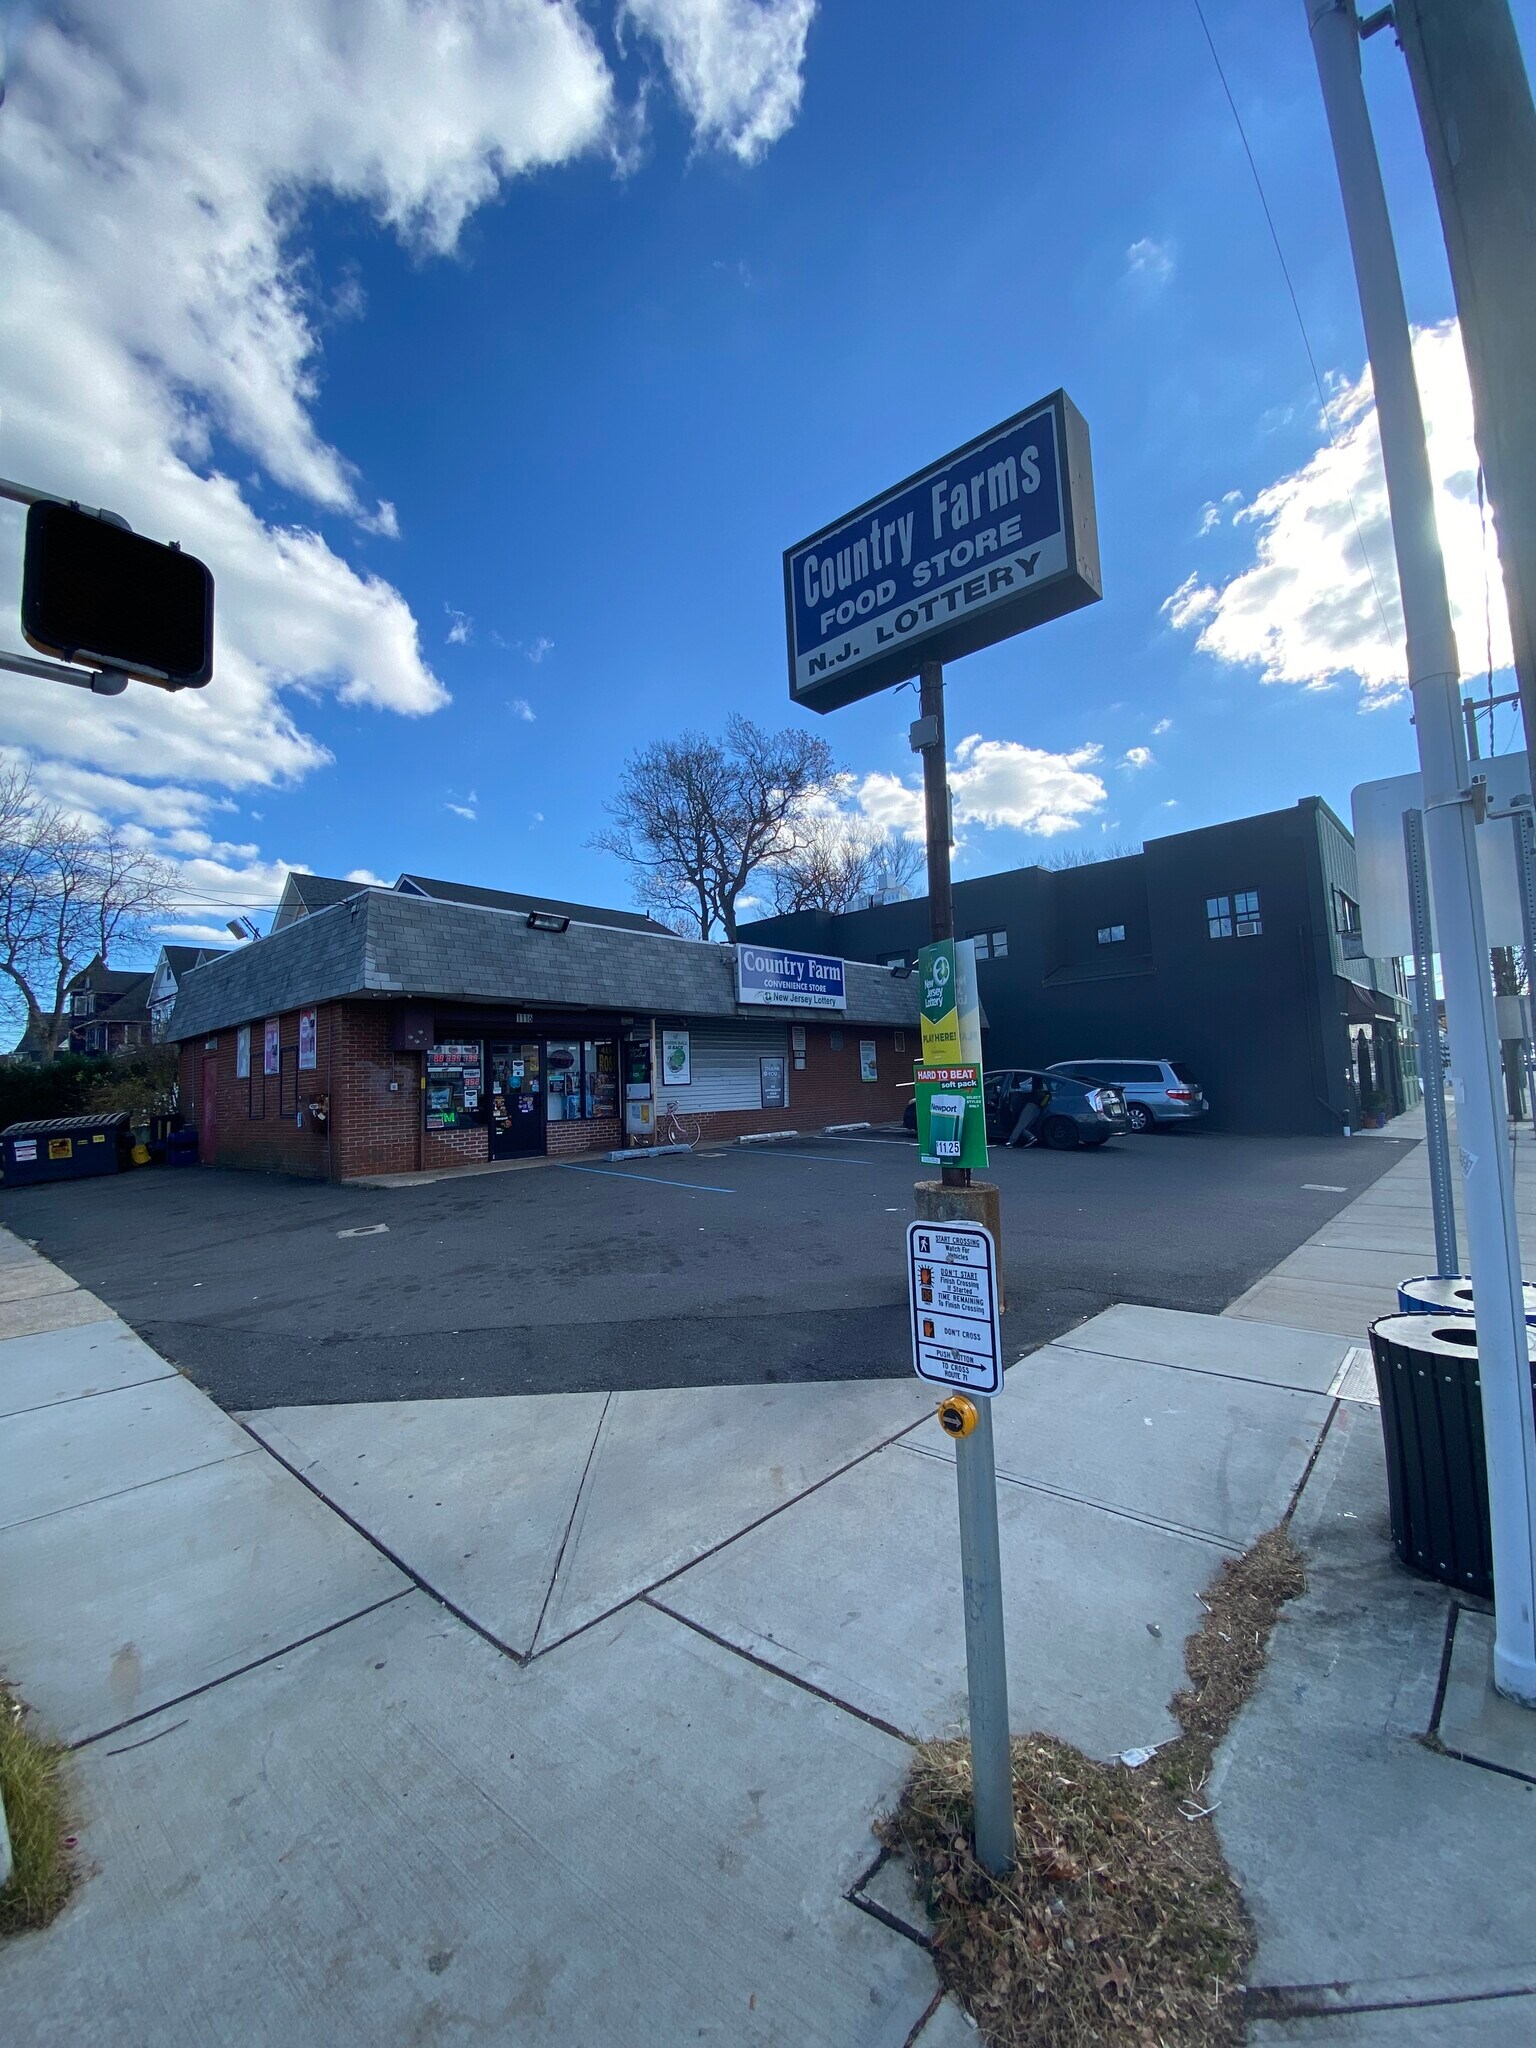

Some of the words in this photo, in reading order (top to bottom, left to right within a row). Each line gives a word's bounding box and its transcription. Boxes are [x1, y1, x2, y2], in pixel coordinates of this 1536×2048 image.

[803, 511, 914, 608] Country
[931, 445, 1041, 540] Farms
[820, 579, 896, 635] FOOD
[912, 514, 1023, 587] STORE
[808, 643, 860, 676] N.J.
[876, 551, 1042, 644] LOTTERY
[743, 951, 805, 982] Country
[808, 960, 841, 981] Farm
[764, 979, 808, 991] CONVENIENCE
[809, 983, 827, 993] STORE
[924, 980, 934, 989] New
[926, 987, 943, 998] Jersey
[773, 992, 788, 1001] New
[789, 993, 813, 1006] Jersey
[813, 995, 836, 1007] Lottery
[924, 997, 944, 1008] Lottery
[923, 1034, 935, 1043] PLAY
[917, 1071, 936, 1080] HARD
[938, 1070, 948, 1079] TO
[950, 1069, 974, 1079] BEAT
[941, 1081, 956, 1089] soft
[957, 1080, 977, 1089] pack
[931, 1103, 957, 1113] Newport
[935, 1235, 951, 1243] START
[952, 1236, 980, 1247] CROSSING
[945, 1244, 961, 1252] Watch
[962, 1246, 970, 1254] For
[940, 1268, 958, 1277] DON'T
[960, 1271, 978, 1280] START
[940, 1277, 956, 1285] Finish
[956, 1279, 979, 1290] Crossing
[953, 1286, 973, 1295] Started
[938, 1292, 950, 1301] TIME
[952, 1294, 984, 1306] REMAINING
[938, 1299, 944, 1307] To
[945, 1301, 960, 1310] Finish
[961, 1304, 985, 1316] Crossing
[944, 1327, 960, 1336] DON'T
[962, 1331, 981, 1341] CROSS
[936, 1349, 951, 1358] PUSH
[942, 1362, 949, 1370] TO
[950, 1364, 970, 1374] CROSS
[944, 1370, 961, 1379] ROUTE
